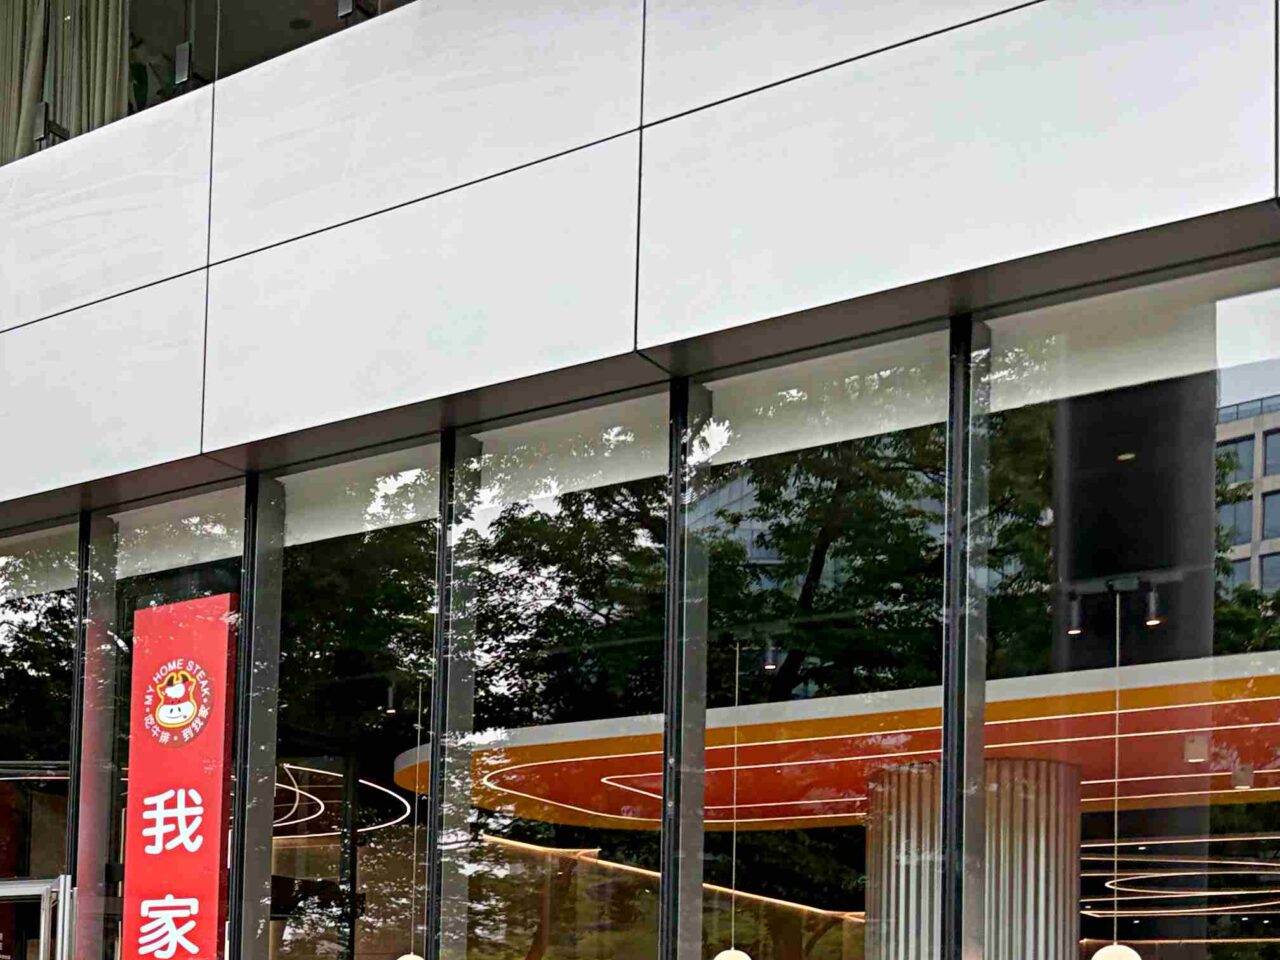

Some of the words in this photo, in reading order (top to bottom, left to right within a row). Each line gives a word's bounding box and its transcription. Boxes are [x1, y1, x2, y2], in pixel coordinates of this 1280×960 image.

[144, 685, 155, 706] MY
[153, 658, 184, 684] HOME
[186, 660, 211, 698] STEAK
